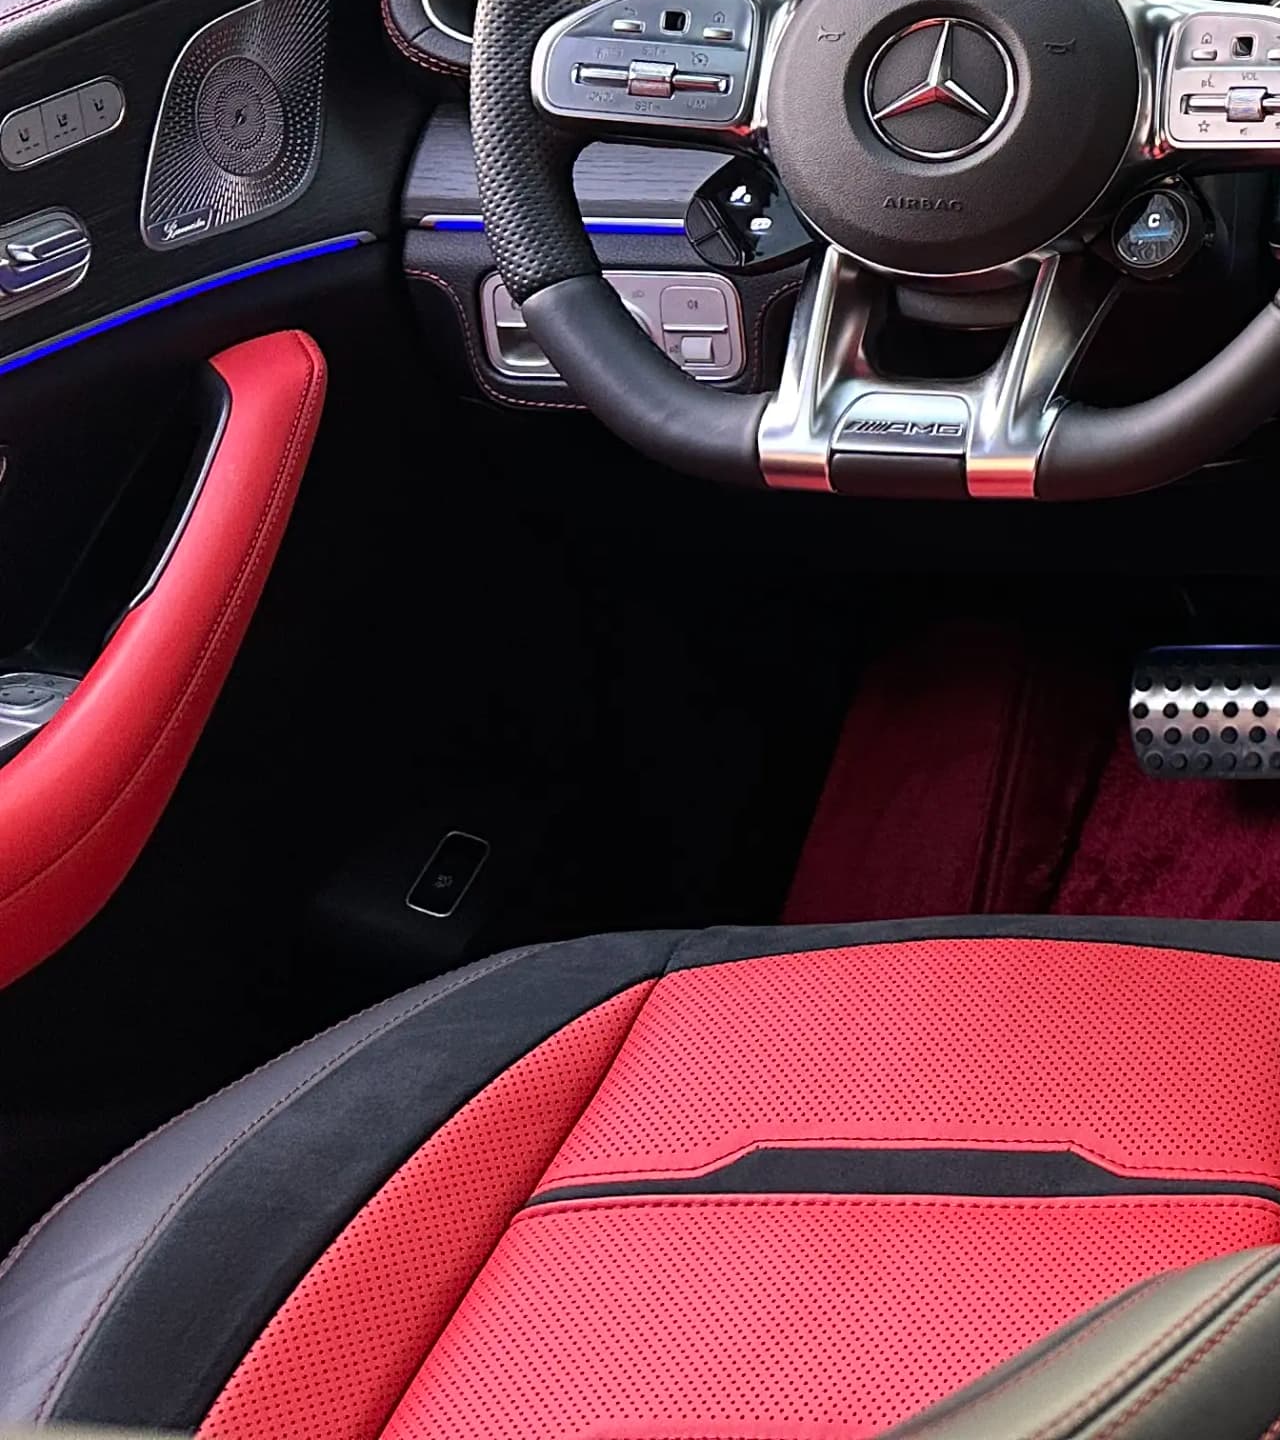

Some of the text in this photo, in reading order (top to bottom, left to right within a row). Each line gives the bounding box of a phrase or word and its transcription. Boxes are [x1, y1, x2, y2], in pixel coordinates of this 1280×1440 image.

[1241, 72, 1259, 81] VOL
[882, 196, 964, 211] AIRBAG
[1147, 213, 1161, 229] C
[880, 420, 964, 437] AMG
